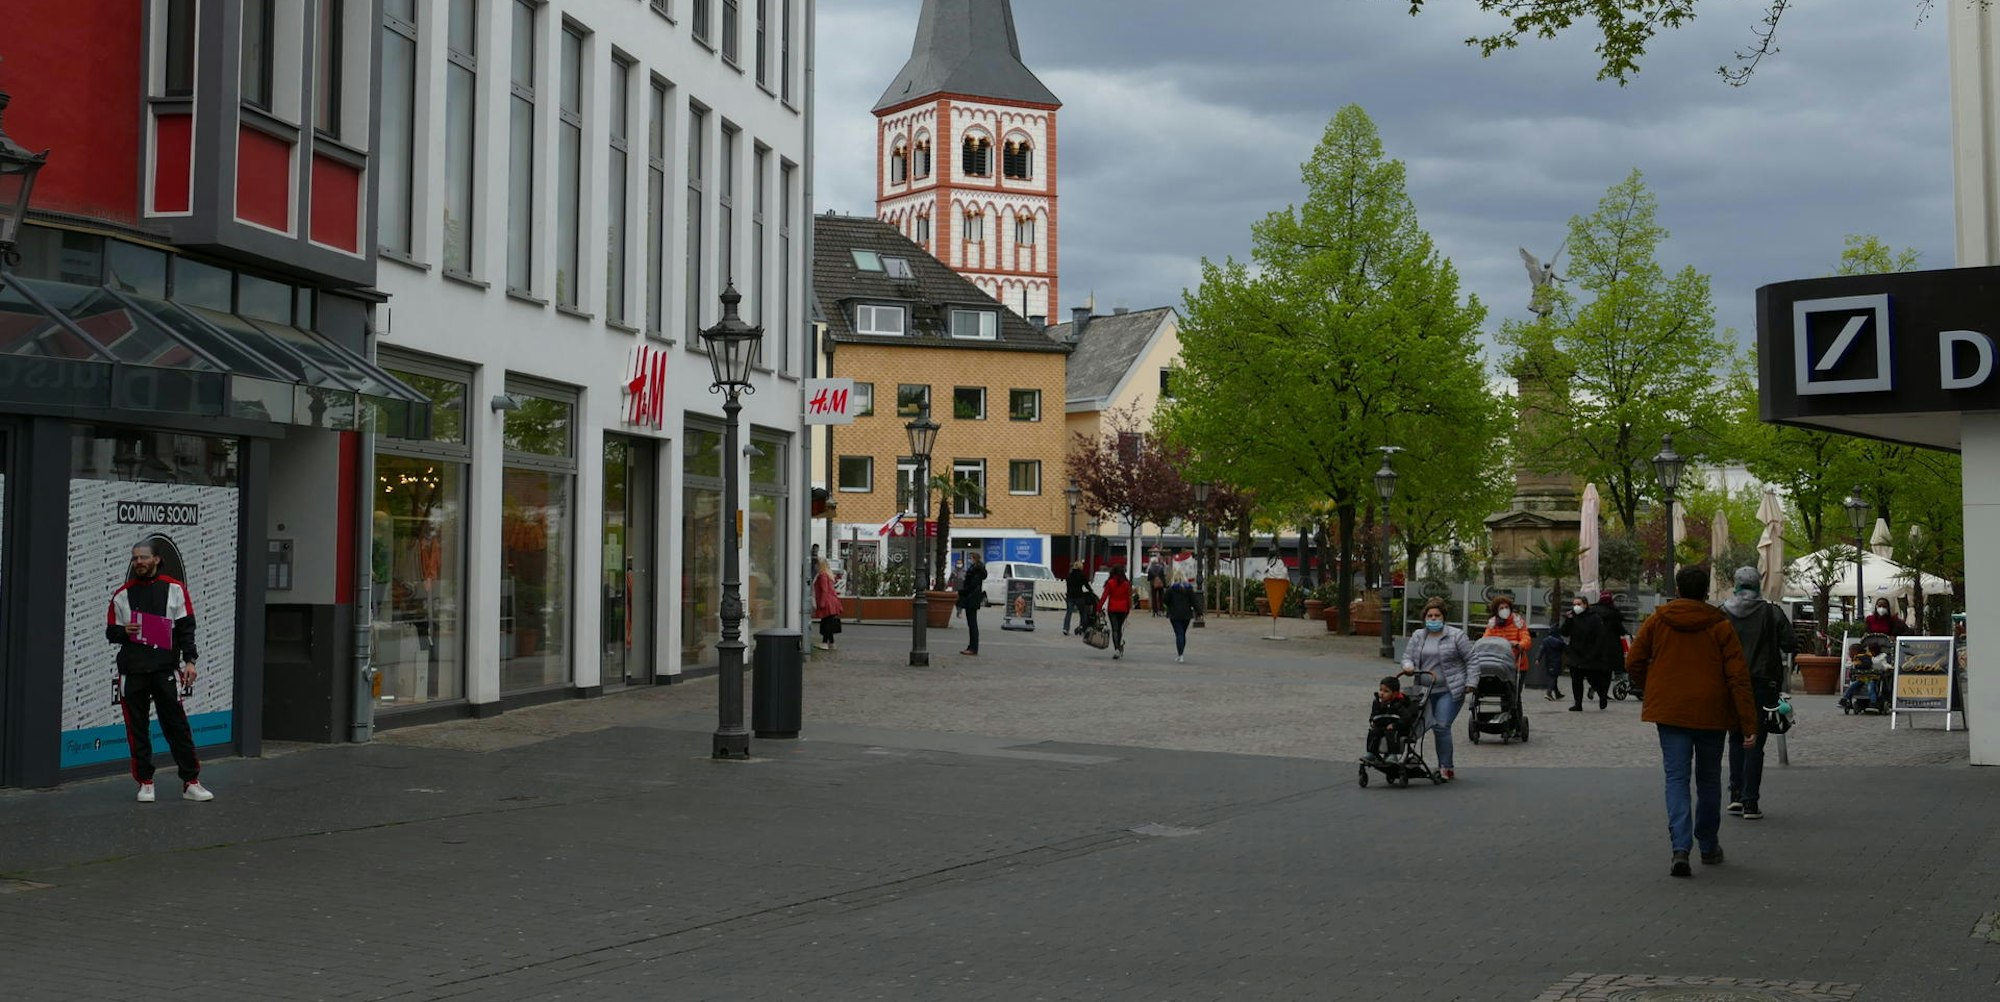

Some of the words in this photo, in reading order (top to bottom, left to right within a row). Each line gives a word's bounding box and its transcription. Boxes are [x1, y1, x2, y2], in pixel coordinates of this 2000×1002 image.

[1939, 330, 1995, 390] D
[625, 344, 667, 431] H&M
[809, 388, 848, 415] H&M
[119, 504, 165, 523] COMING
[166, 506, 197, 524] SOON
[862, 551, 903, 563] MILNO
[1902, 686, 1946, 696] ANKAUF
[1907, 677, 1938, 686] GOLD
